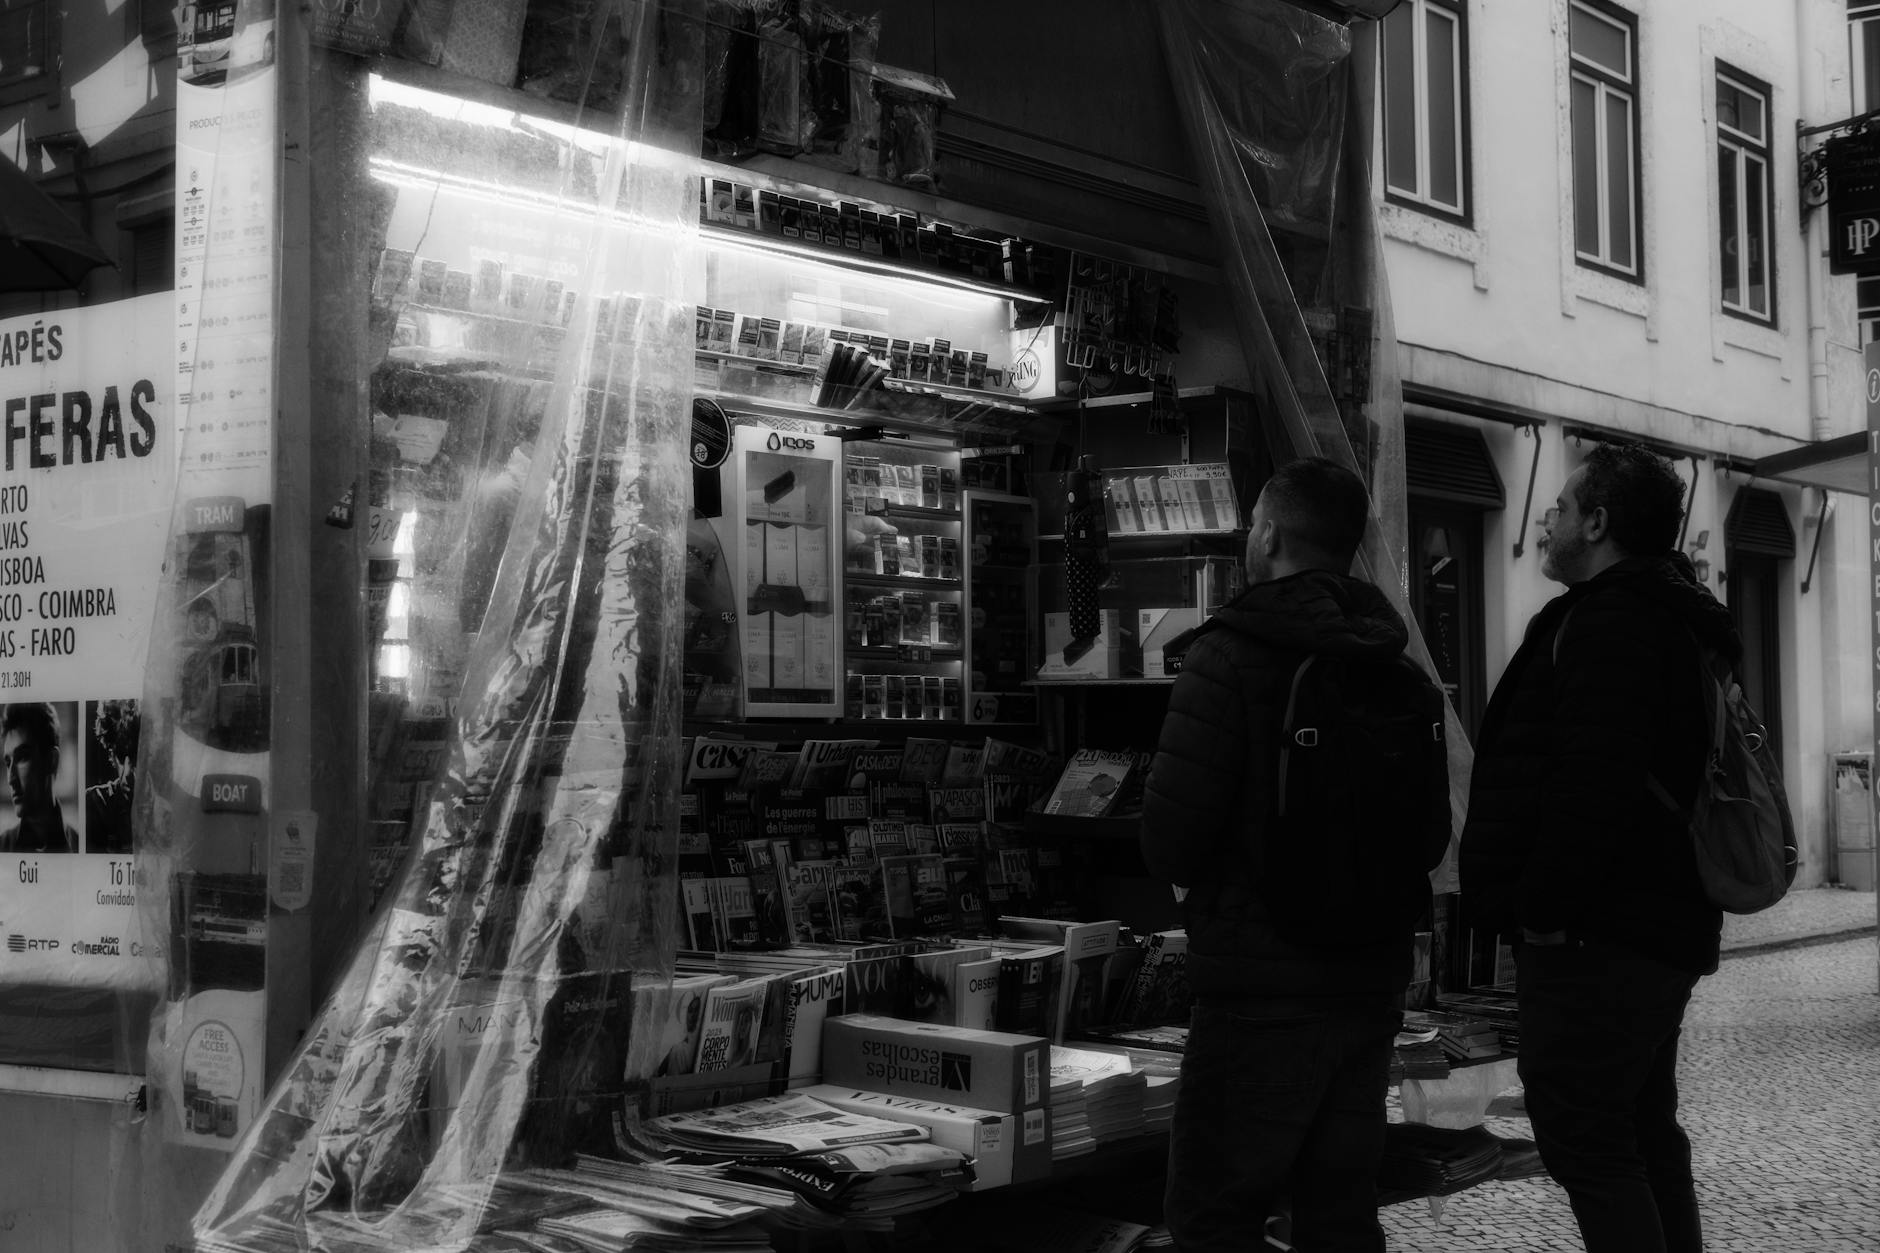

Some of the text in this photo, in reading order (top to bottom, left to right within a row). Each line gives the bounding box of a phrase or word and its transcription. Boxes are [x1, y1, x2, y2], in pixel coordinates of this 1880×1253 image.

[0, 320, 62, 368] APÉS
[5, 379, 156, 471] FERAS
[782, 437, 815, 450] IQOS
[195, 505, 233, 524] TRAM
[39, 588, 116, 619] COIMBRA
[31, 627, 75, 656] FARO
[211, 784, 247, 803] BOAT
[765, 807, 817, 821] Les guerres
[19, 861, 38, 884] Gui
[110, 862, 122, 886] Tó
[28, 939, 59, 951] RTP
[204, 1028, 225, 1041] FREE
[703, 1036, 731, 1051] CORPO
[199, 1040, 230, 1053] ACCESS
[700, 1050, 727, 1062] MENTE
[861, 1040, 941, 1064] escolhas
[865, 1062, 941, 1087] grandes
